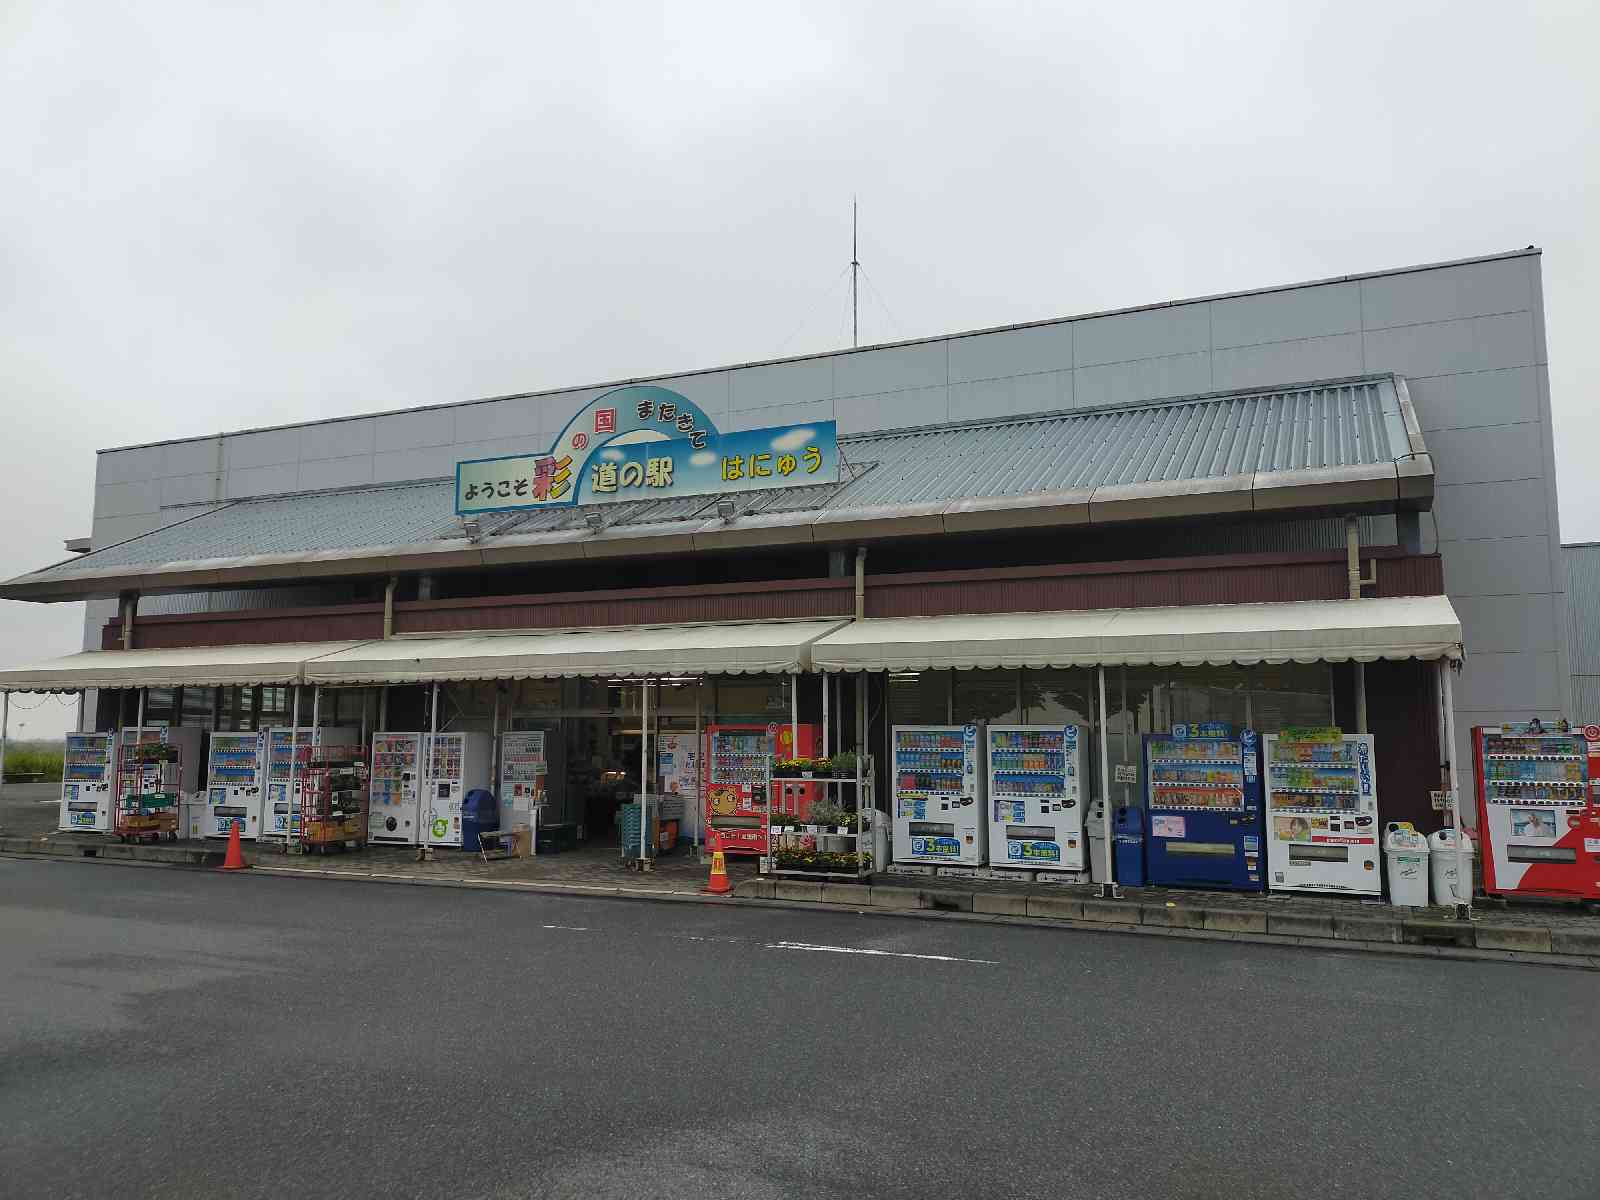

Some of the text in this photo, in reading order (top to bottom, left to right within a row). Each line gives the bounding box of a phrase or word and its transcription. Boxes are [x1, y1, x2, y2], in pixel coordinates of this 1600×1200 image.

[637, 400, 707, 449] またきて
[464, 479, 529, 501] ようこそ
[591, 447, 822, 493] 道の駅 はにゅう
